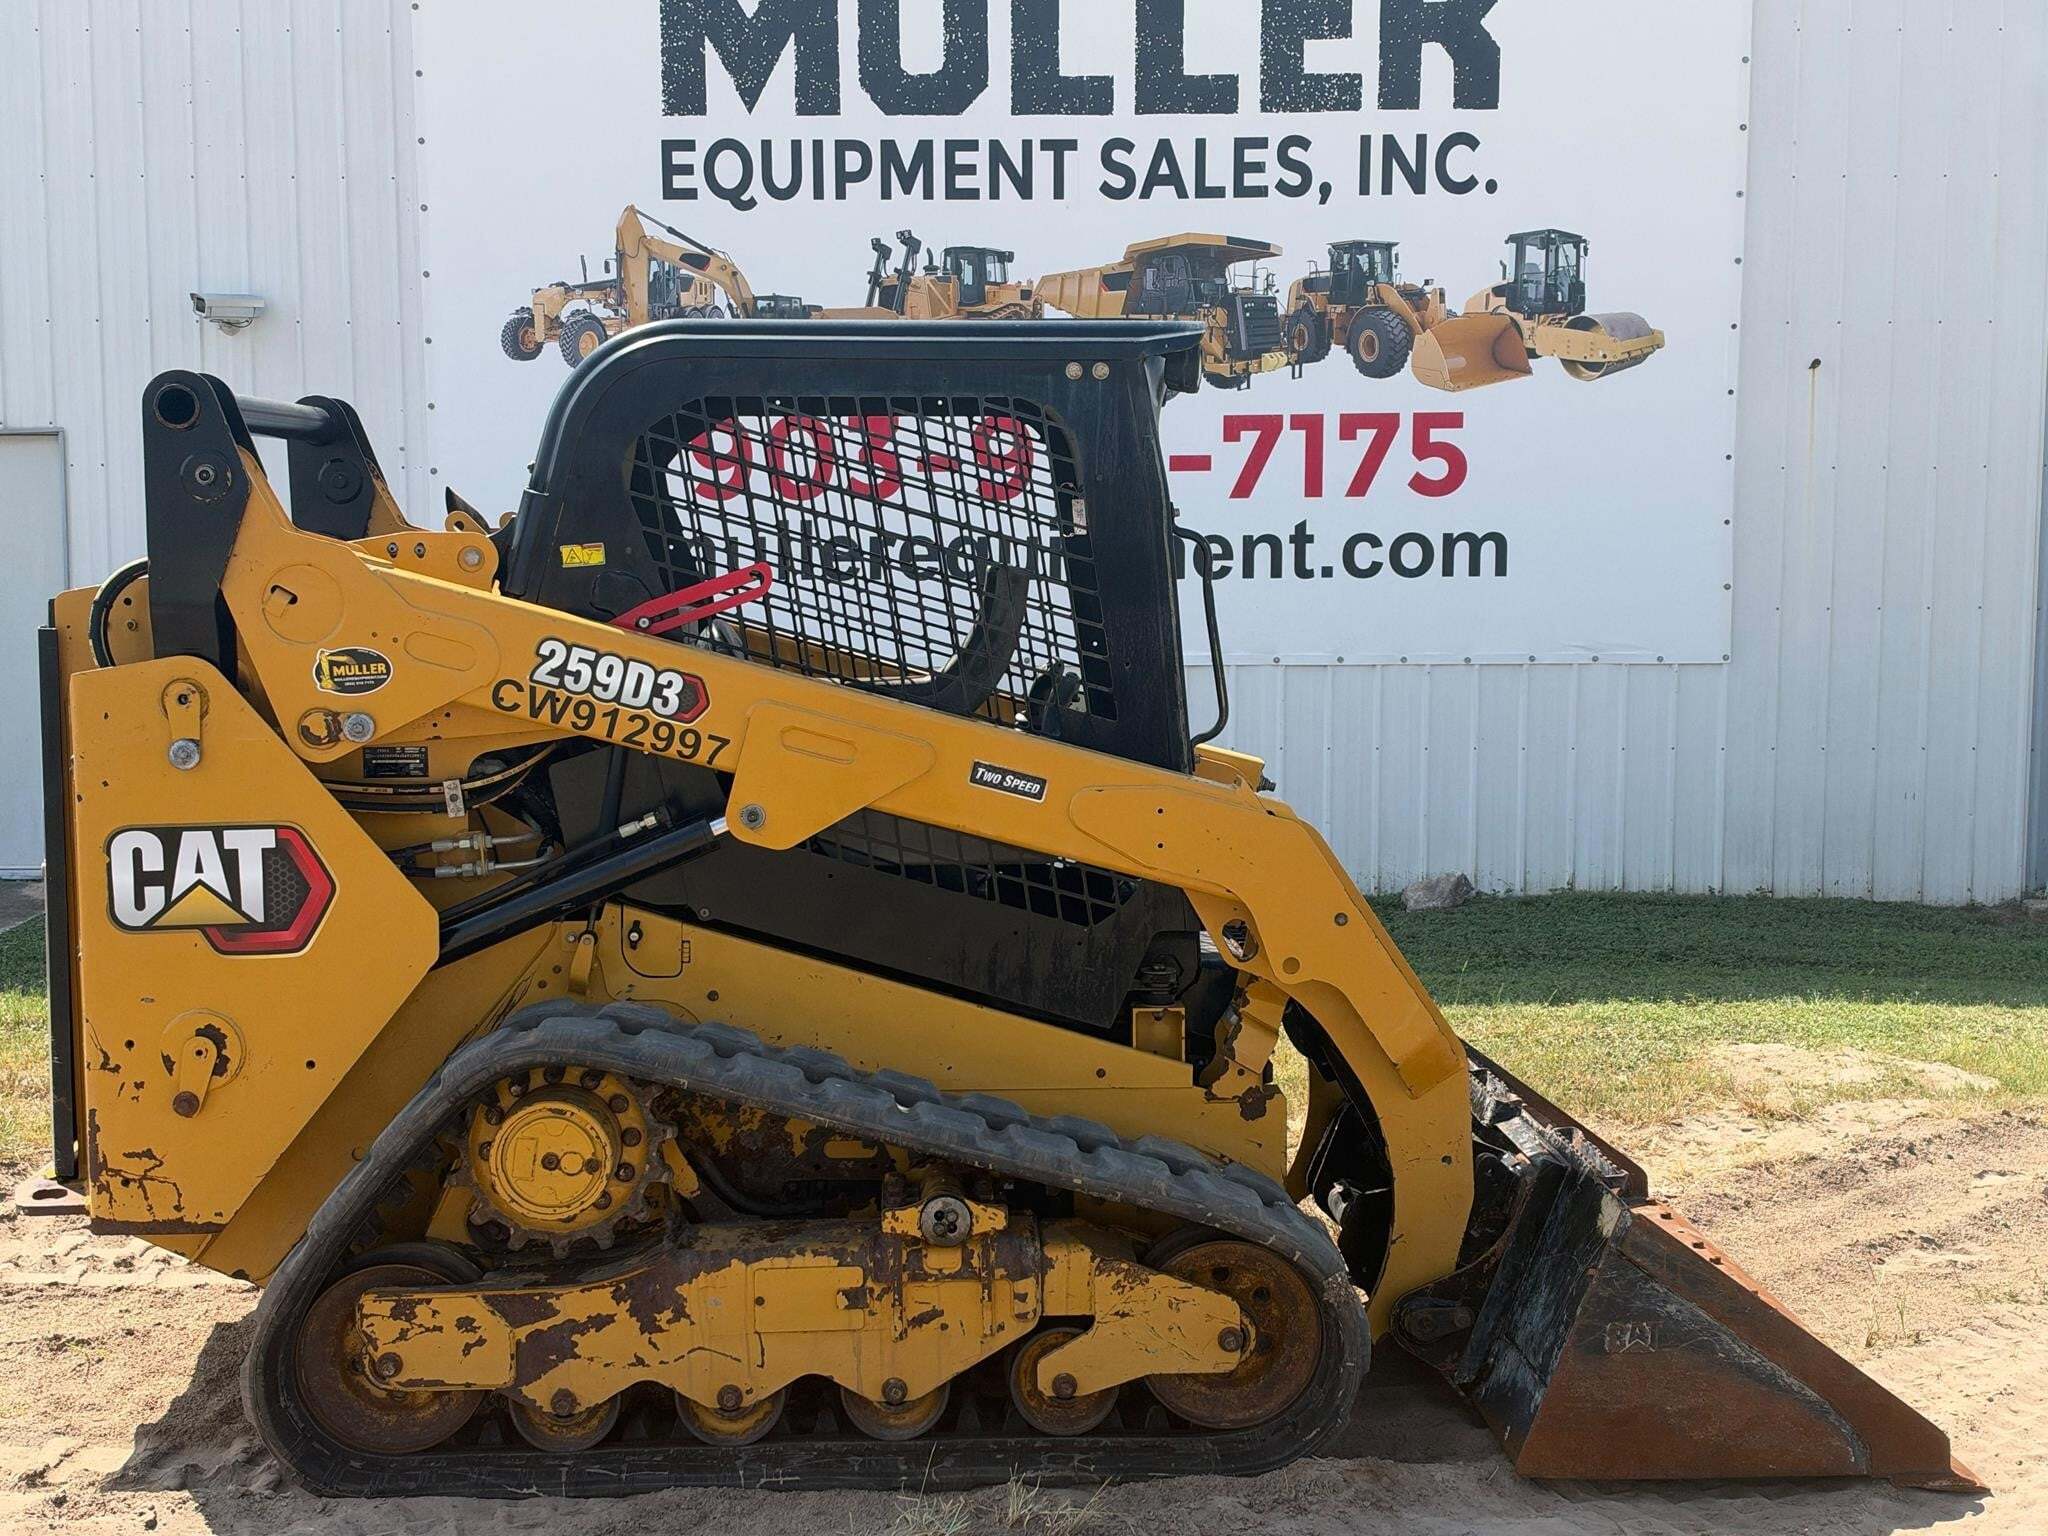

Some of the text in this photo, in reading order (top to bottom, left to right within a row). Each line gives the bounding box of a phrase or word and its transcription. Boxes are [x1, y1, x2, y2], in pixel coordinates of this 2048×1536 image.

[660, 0, 1501, 116] MULLER
[660, 131, 1498, 212] EQUIPMENT SALES, INC.
[332, 662, 387, 677] MULLER
[532, 640, 684, 716] 259D3
[492, 678, 731, 766] CW912997
[110, 828, 277, 928] CAT
